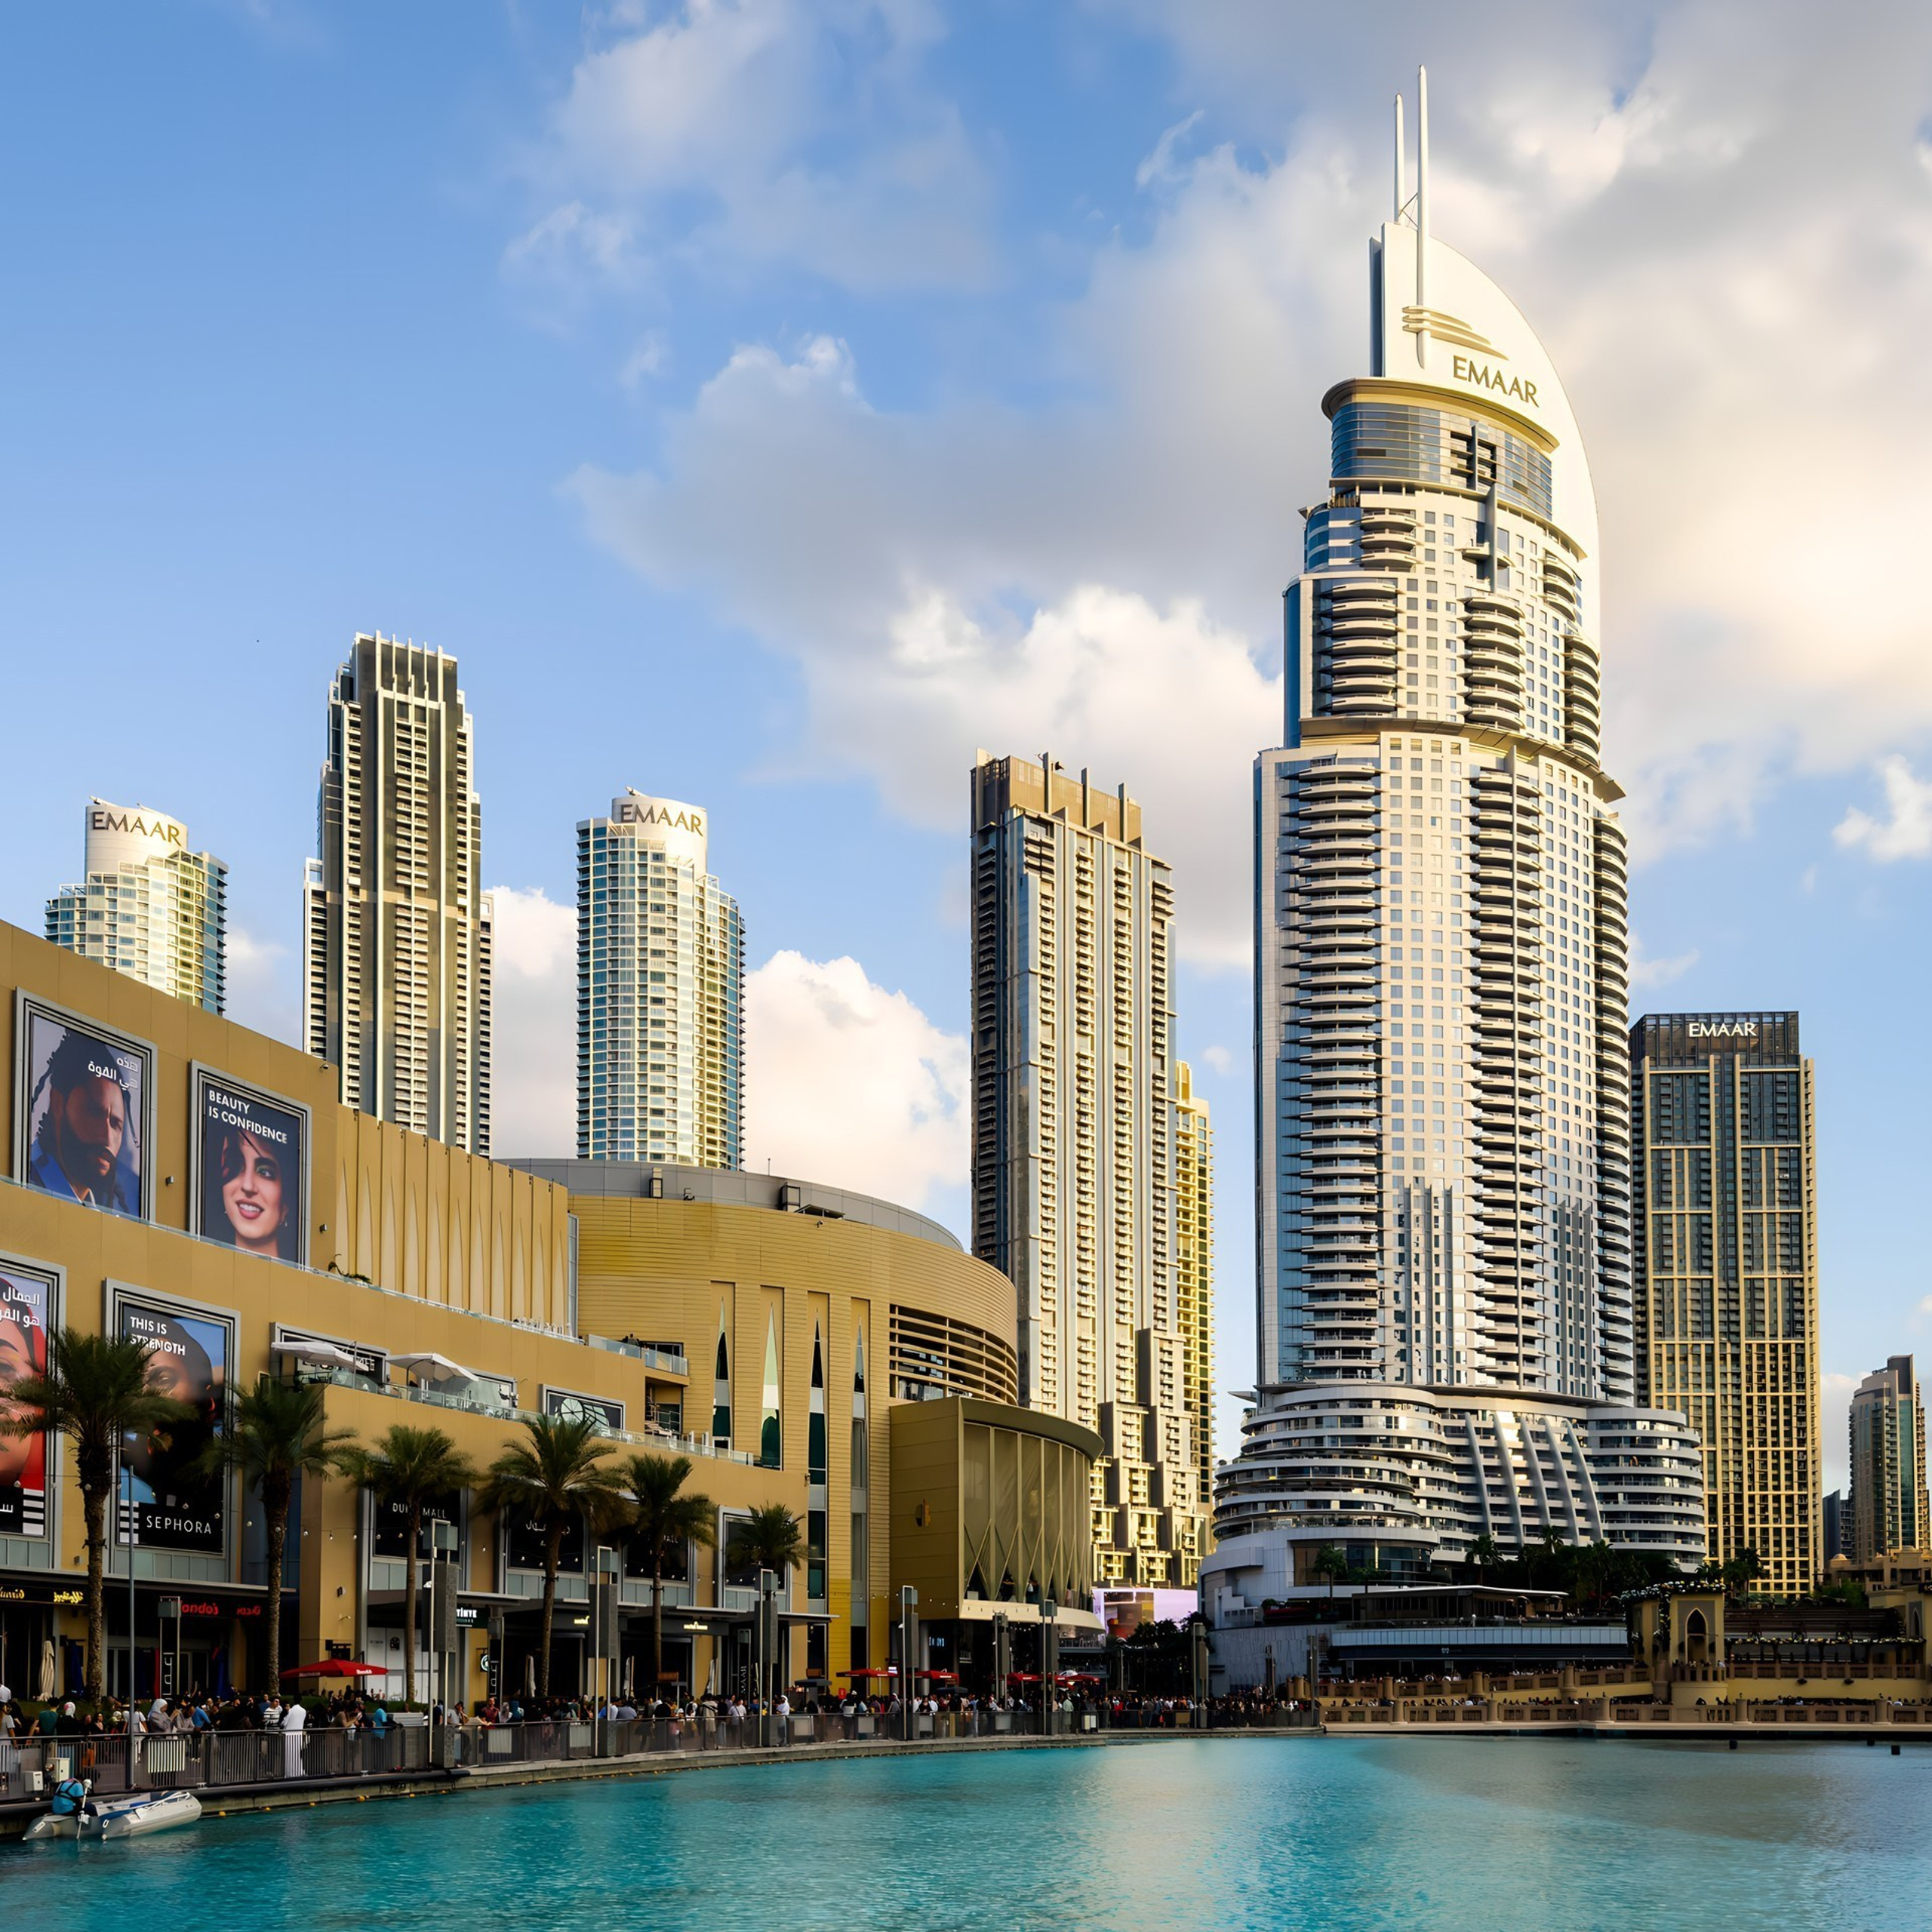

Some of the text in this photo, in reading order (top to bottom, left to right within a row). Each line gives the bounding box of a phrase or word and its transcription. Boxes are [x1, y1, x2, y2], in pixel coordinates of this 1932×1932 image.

[1454, 355, 1540, 408] EMAAR
[92, 811, 182, 847] EMAAR
[620, 804, 703, 837] EMAAR
[1689, 1022, 1758, 1038] EMAAR
[116, 1057, 138, 1072] هذه
[88, 1060, 138, 1091] هي القوة
[209, 1090, 250, 1114] BEAUTY
[208, 1106, 288, 1144] IS CONFIDENCE
[2, 1286, 40, 1307] الجمال
[0, 1308, 40, 1328] هو الق
[130, 1316, 167, 1334] THIS IS
[423, 1507, 447, 1518] MALL
[146, 1515, 211, 1534] SEPHORA
[180, 1601, 219, 1615] ando's
